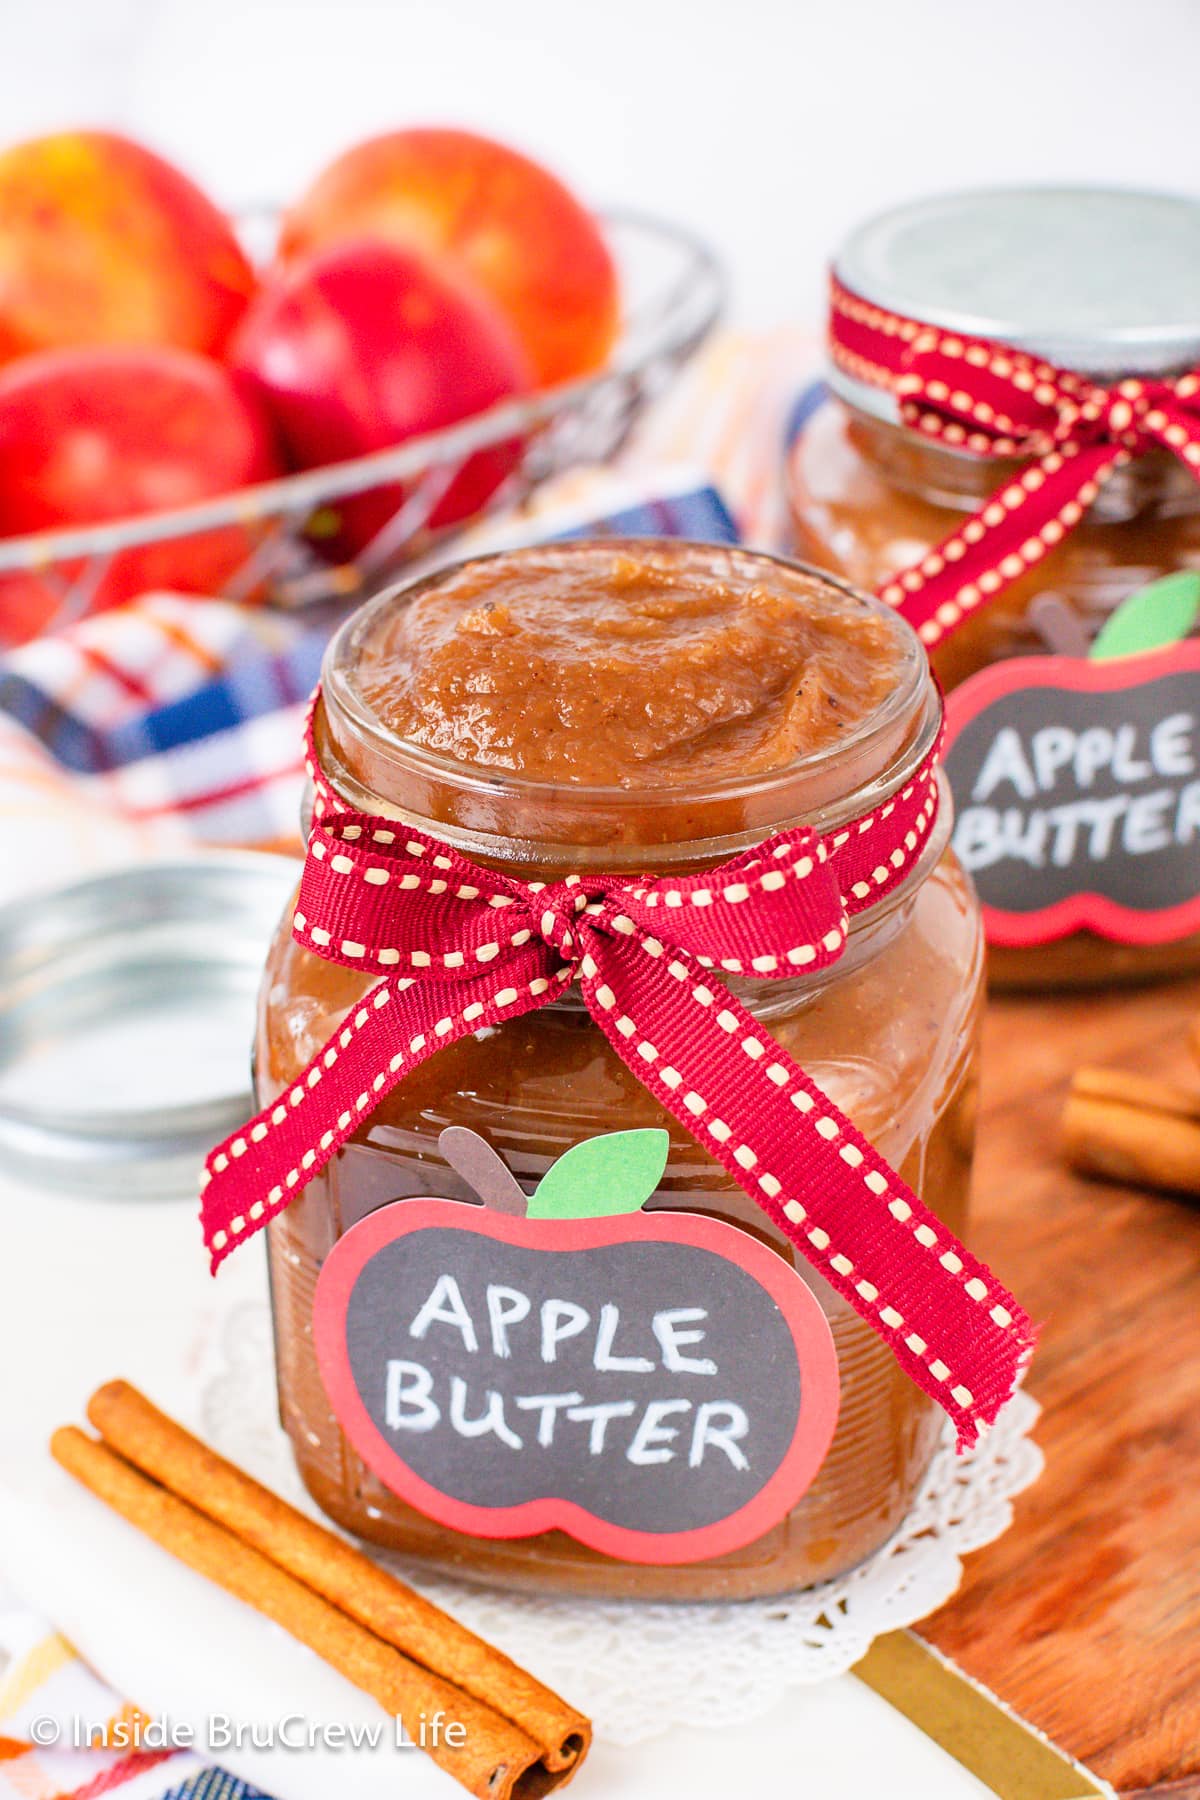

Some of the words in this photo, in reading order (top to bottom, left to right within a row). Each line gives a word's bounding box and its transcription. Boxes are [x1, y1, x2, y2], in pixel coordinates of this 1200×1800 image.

[971, 712, 1196, 801] APPLE
[408, 1274, 718, 1375] APPLE
[384, 1359, 750, 1471] BUTTER
